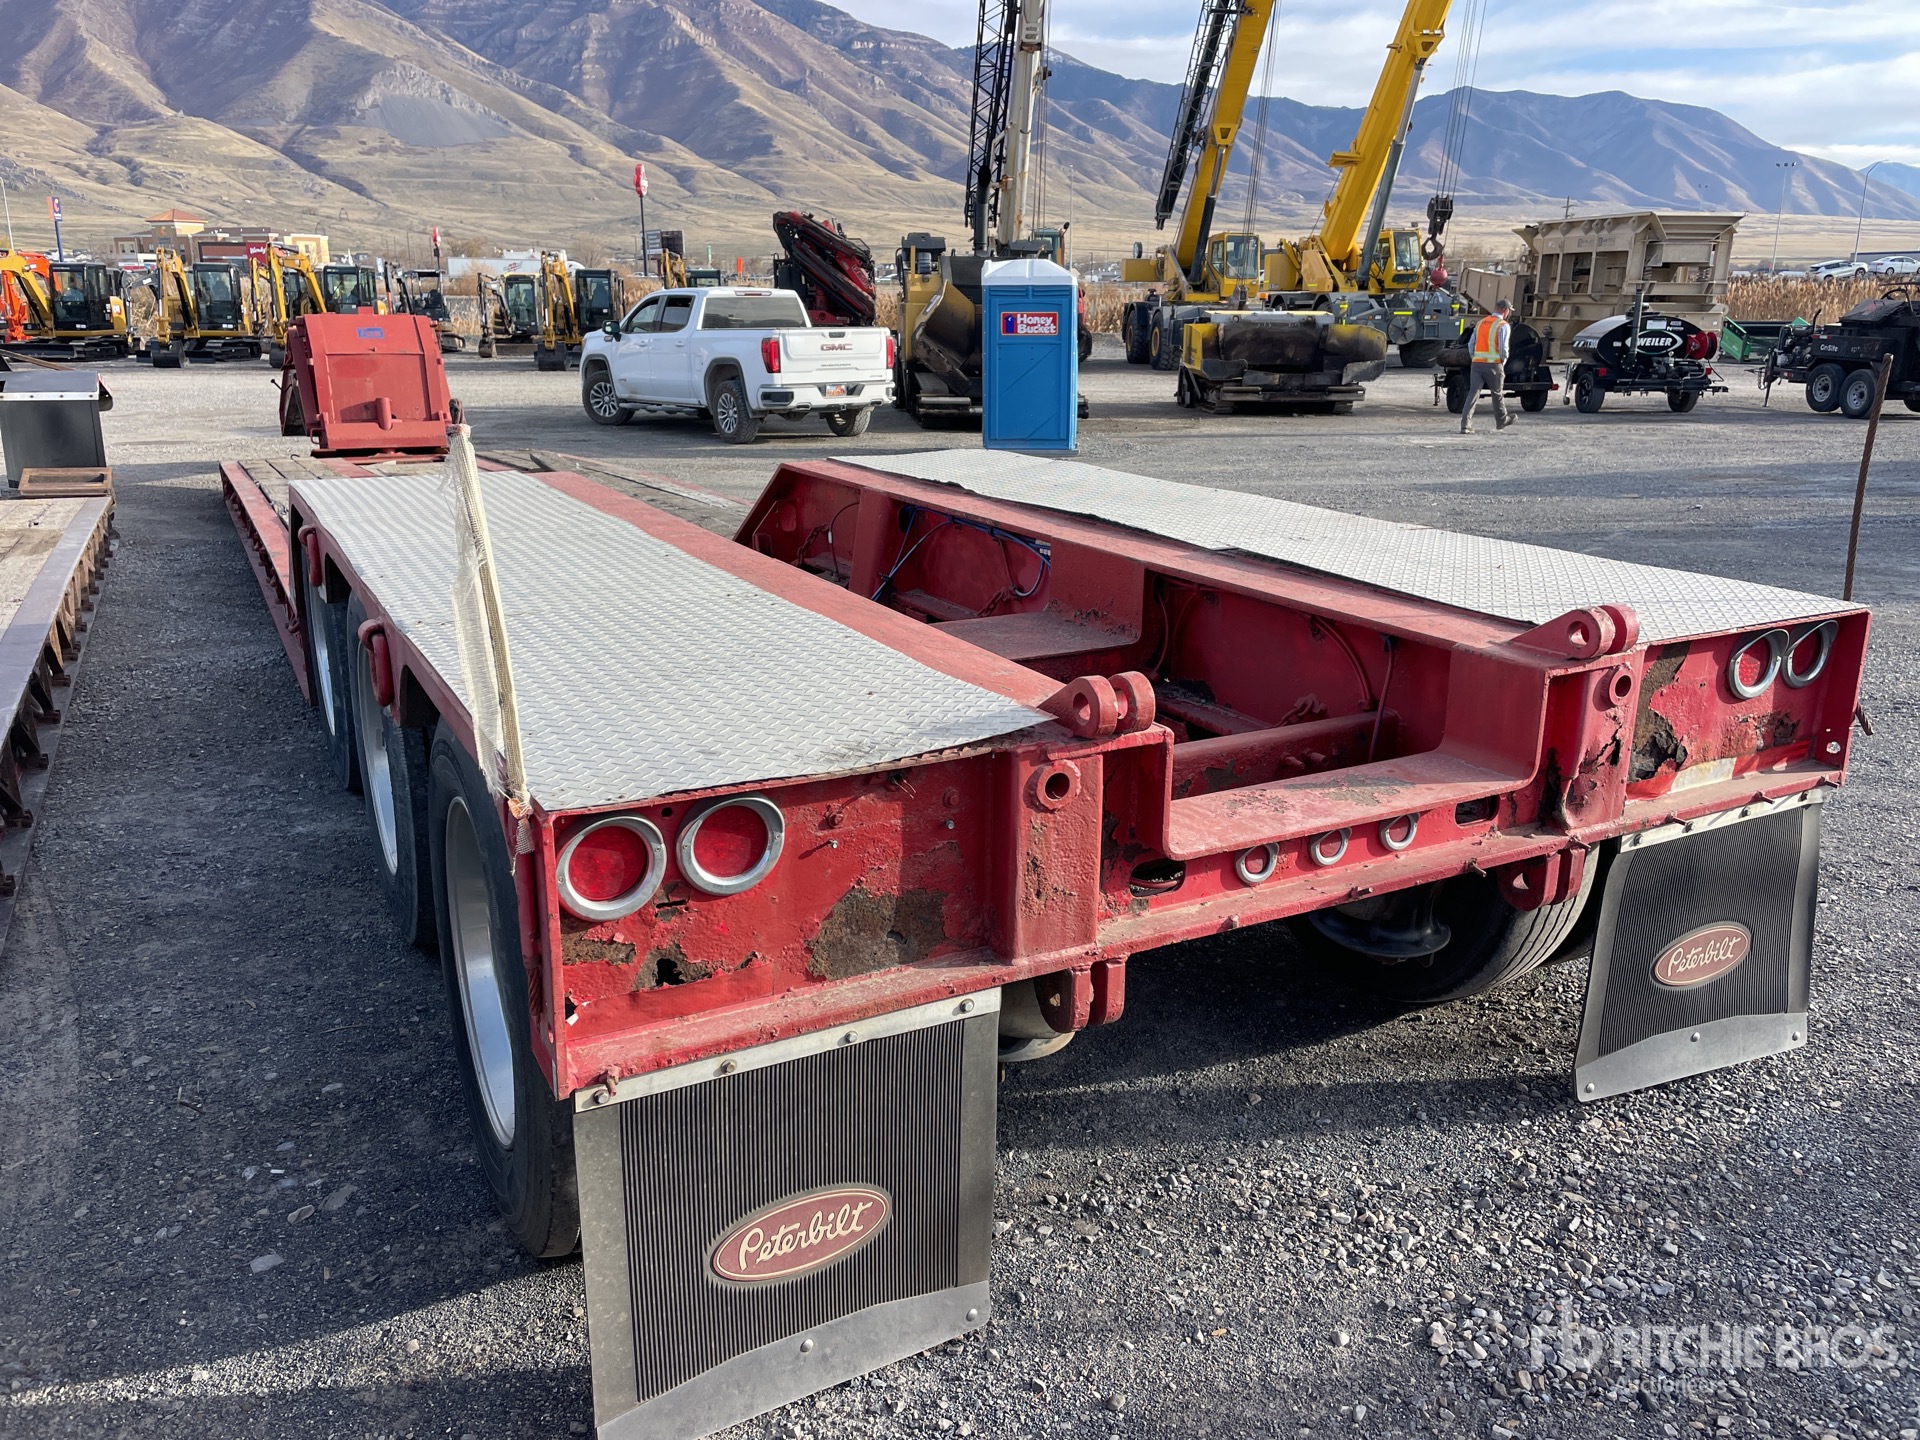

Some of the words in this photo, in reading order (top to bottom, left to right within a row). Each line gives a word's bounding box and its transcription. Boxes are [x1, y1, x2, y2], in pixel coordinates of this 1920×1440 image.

[1017, 314, 1053, 325] Honey
[1018, 324, 1056, 333] Bucket
[820, 343, 853, 351] GMC
[1637, 338, 1673, 346] WEILER
[1667, 936, 1741, 977] Peterbilt
[738, 1201, 874, 1272] Peterbilt
